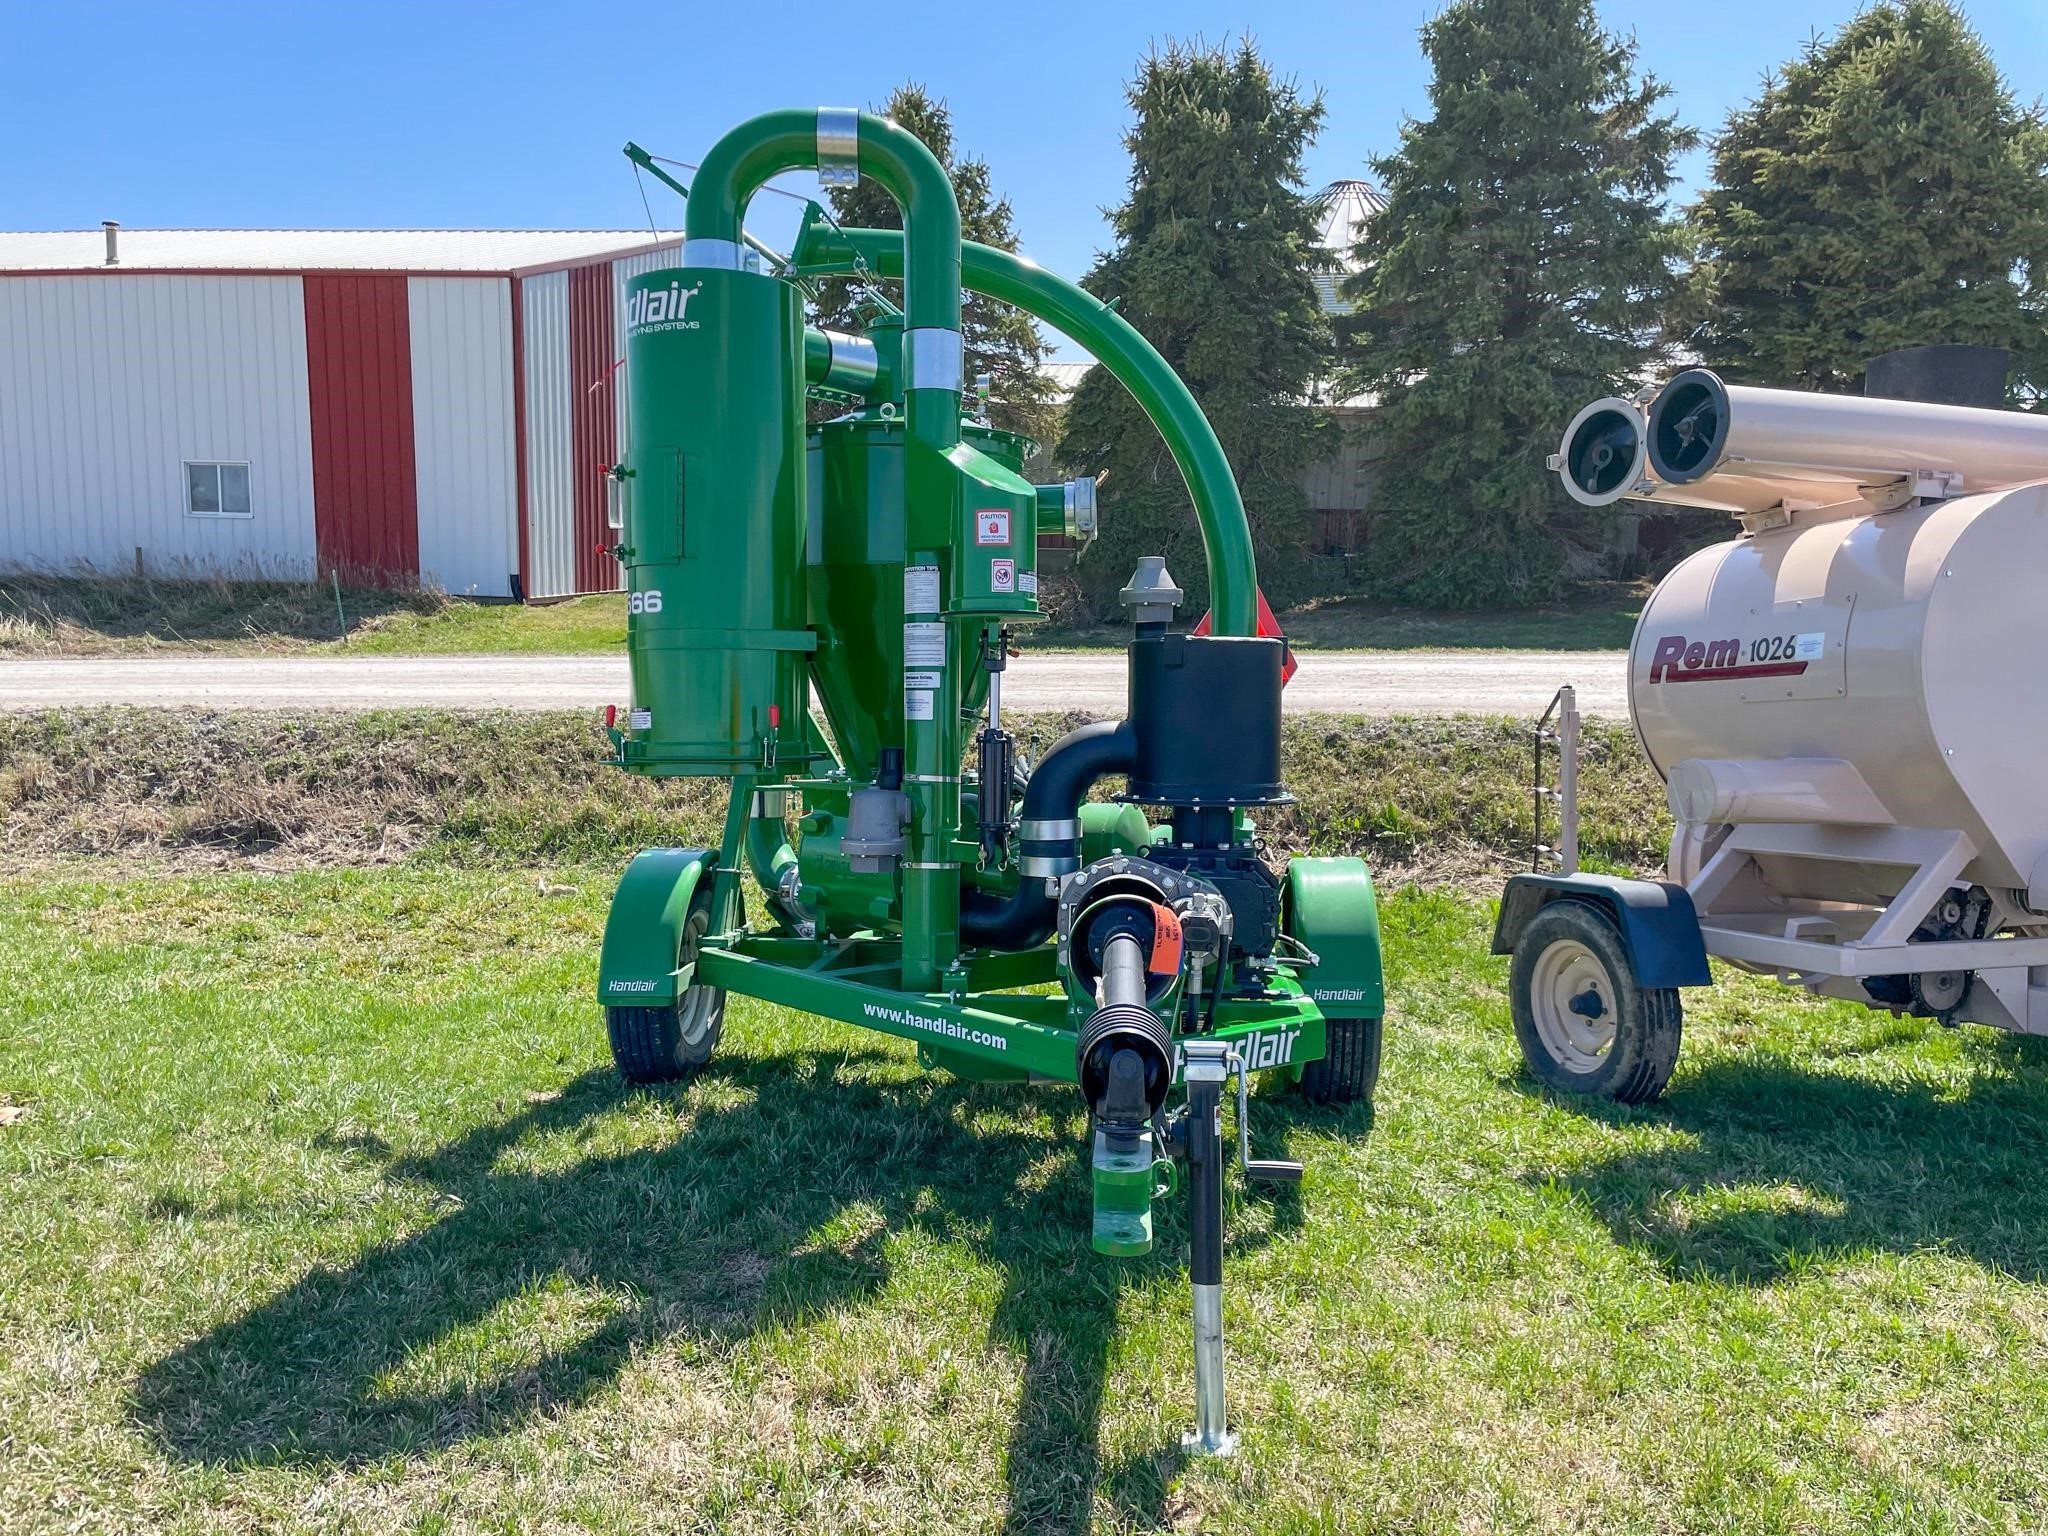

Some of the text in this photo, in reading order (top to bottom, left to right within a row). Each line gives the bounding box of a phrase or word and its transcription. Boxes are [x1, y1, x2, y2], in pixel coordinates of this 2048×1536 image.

[627, 281, 699, 328] dlair
[654, 321, 700, 332] SYSTEMS
[1650, 635, 1797, 684] Rem 1026
[608, 980, 658, 991] Handlair
[1313, 988, 1366, 1001] Handlair
[863, 1003, 1007, 1050] www.handlair.com
[1171, 1024, 1300, 1085] Hdlair
